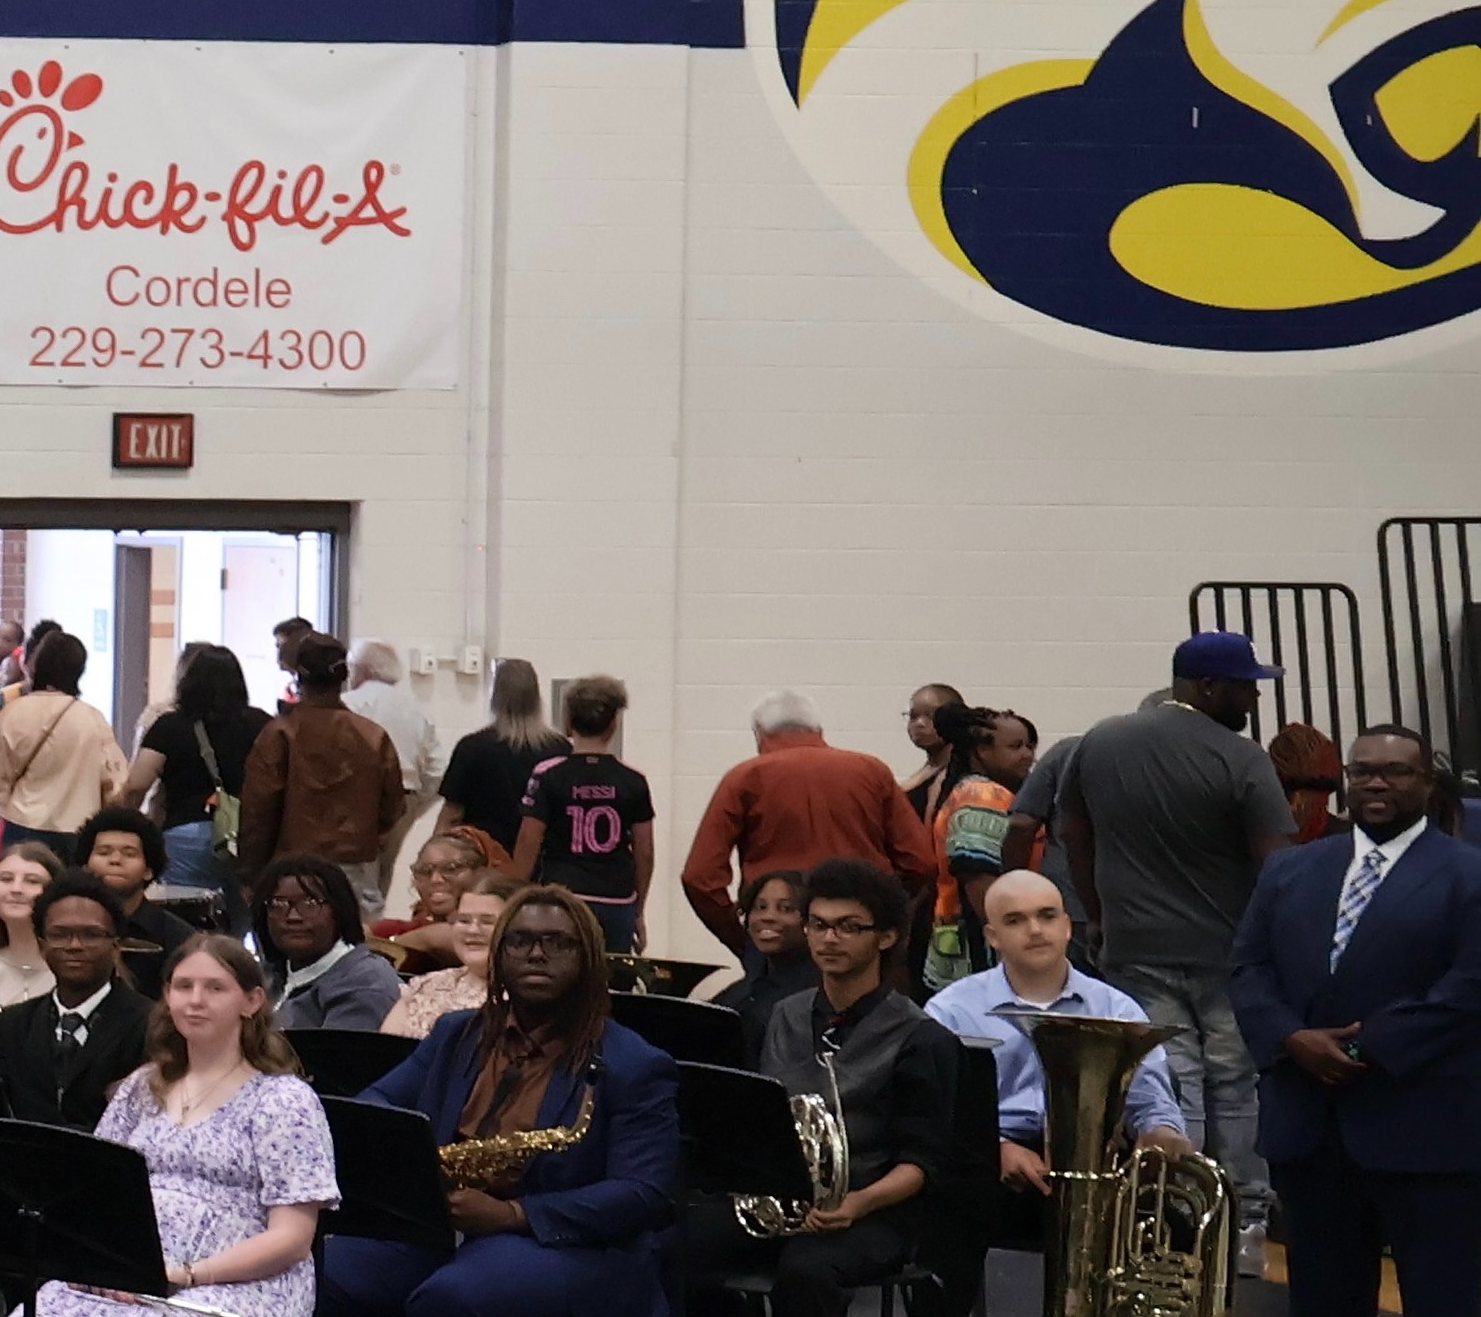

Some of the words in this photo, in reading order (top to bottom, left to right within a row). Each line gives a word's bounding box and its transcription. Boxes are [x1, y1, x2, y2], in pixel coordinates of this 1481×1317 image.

[105, 265, 293, 308] Cordele
[28, 325, 367, 371] 229-273-4300
[129, 423, 182, 459] EXIT
[572, 785, 616, 798] MESSI
[565, 805, 621, 853] 10
